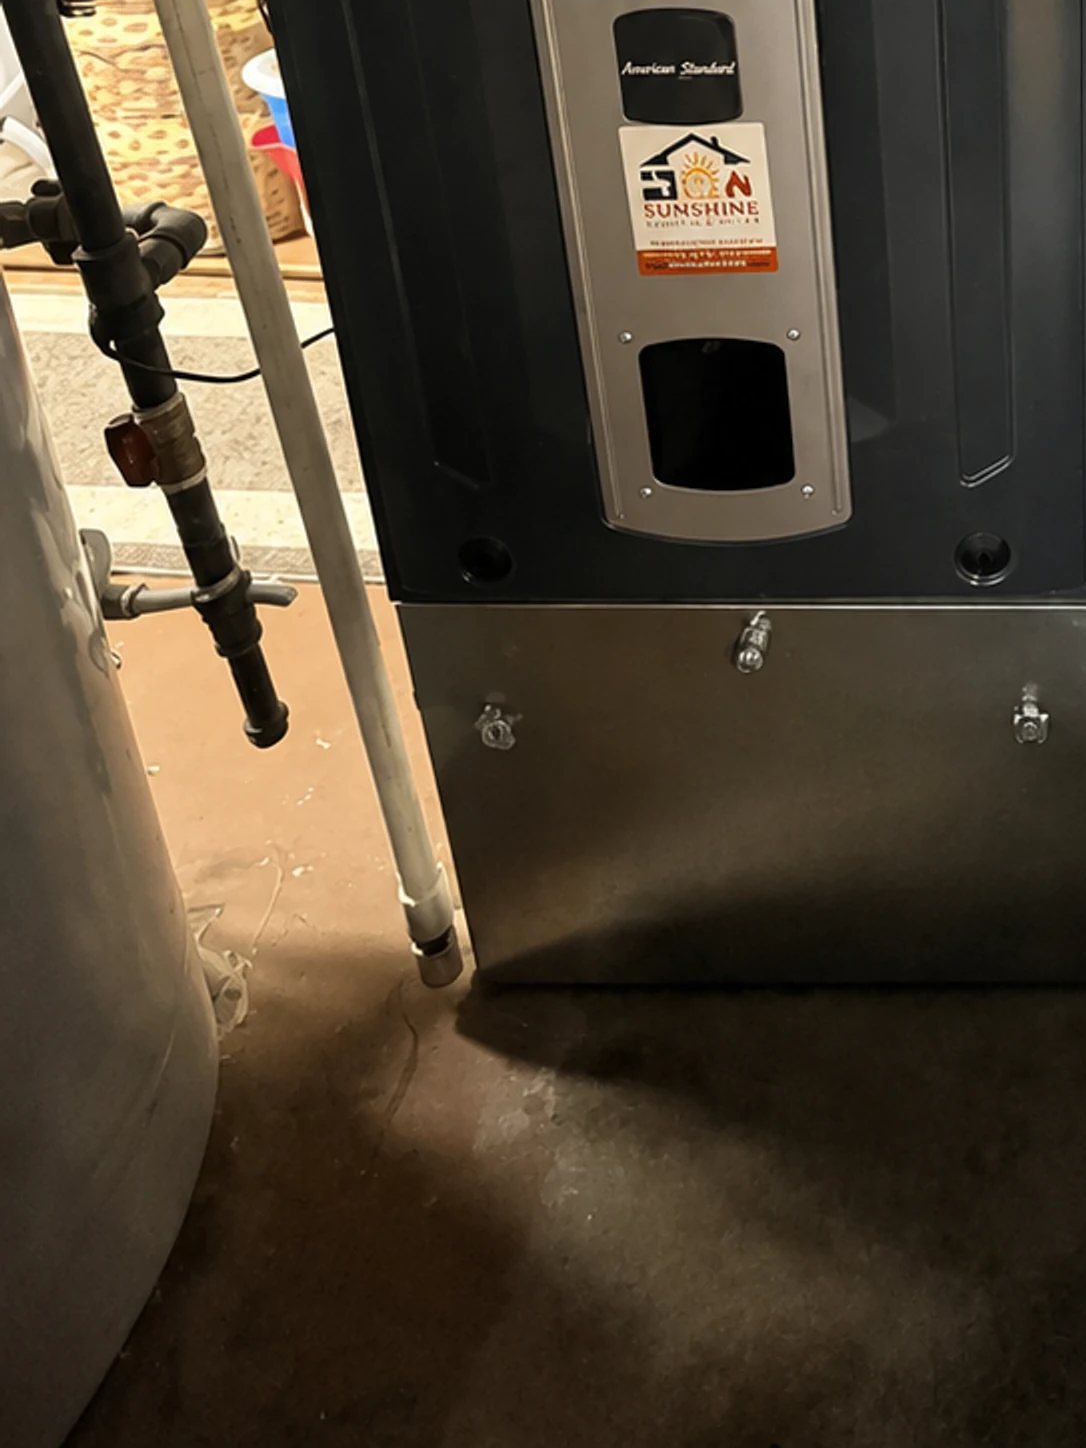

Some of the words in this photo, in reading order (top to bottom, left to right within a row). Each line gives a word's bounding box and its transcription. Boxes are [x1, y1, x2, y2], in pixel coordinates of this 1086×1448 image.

[621, 61, 676, 75] American
[680, 61, 736, 75] Standard
[644, 200, 759, 219] SUNSHINE
